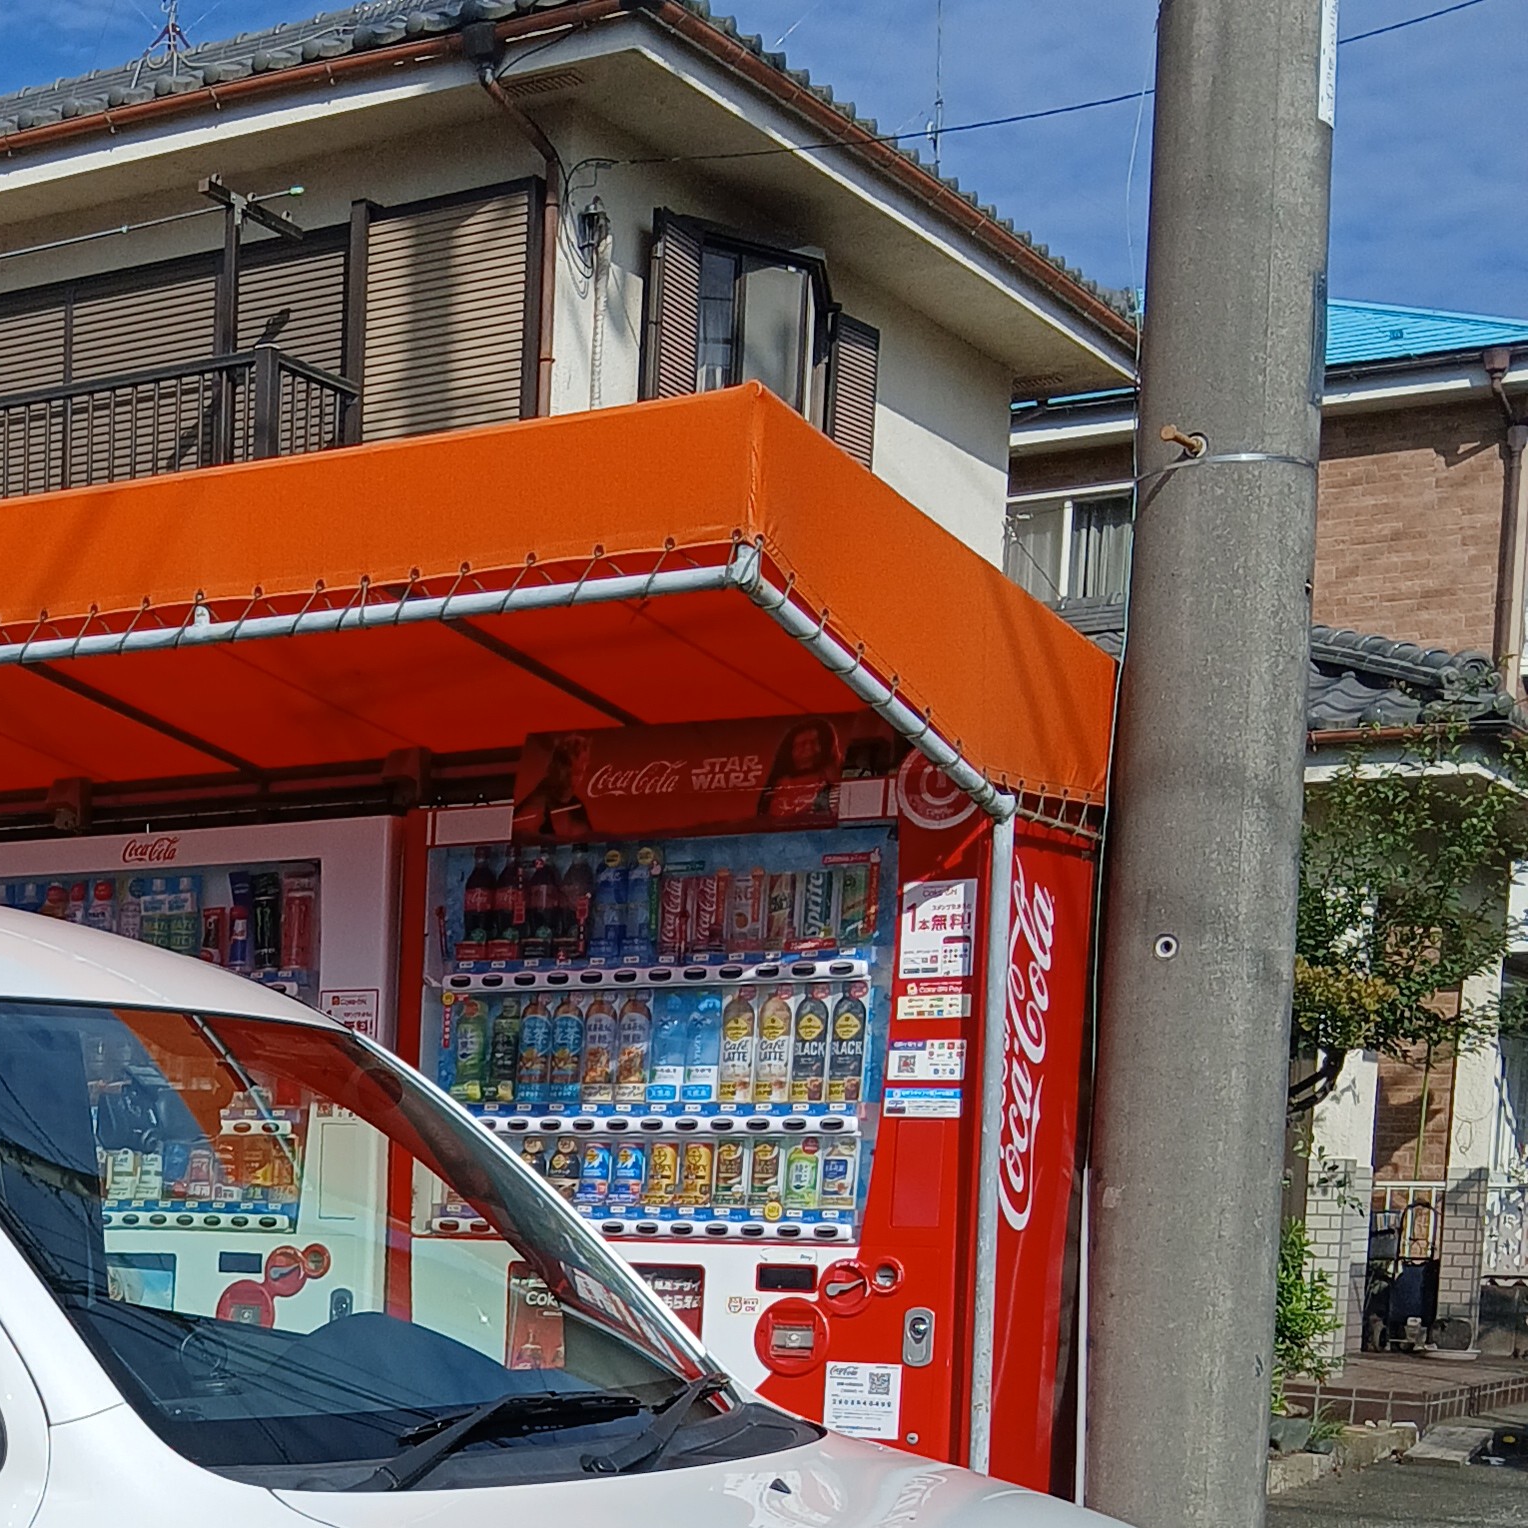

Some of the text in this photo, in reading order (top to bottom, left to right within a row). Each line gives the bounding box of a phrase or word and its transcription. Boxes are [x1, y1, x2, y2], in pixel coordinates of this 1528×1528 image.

[692, 755, 763, 774] STAR
[692, 771, 763, 790] WARS
[723, 1051, 747, 1062] LATTE
[760, 1051, 784, 1062] LATTE
